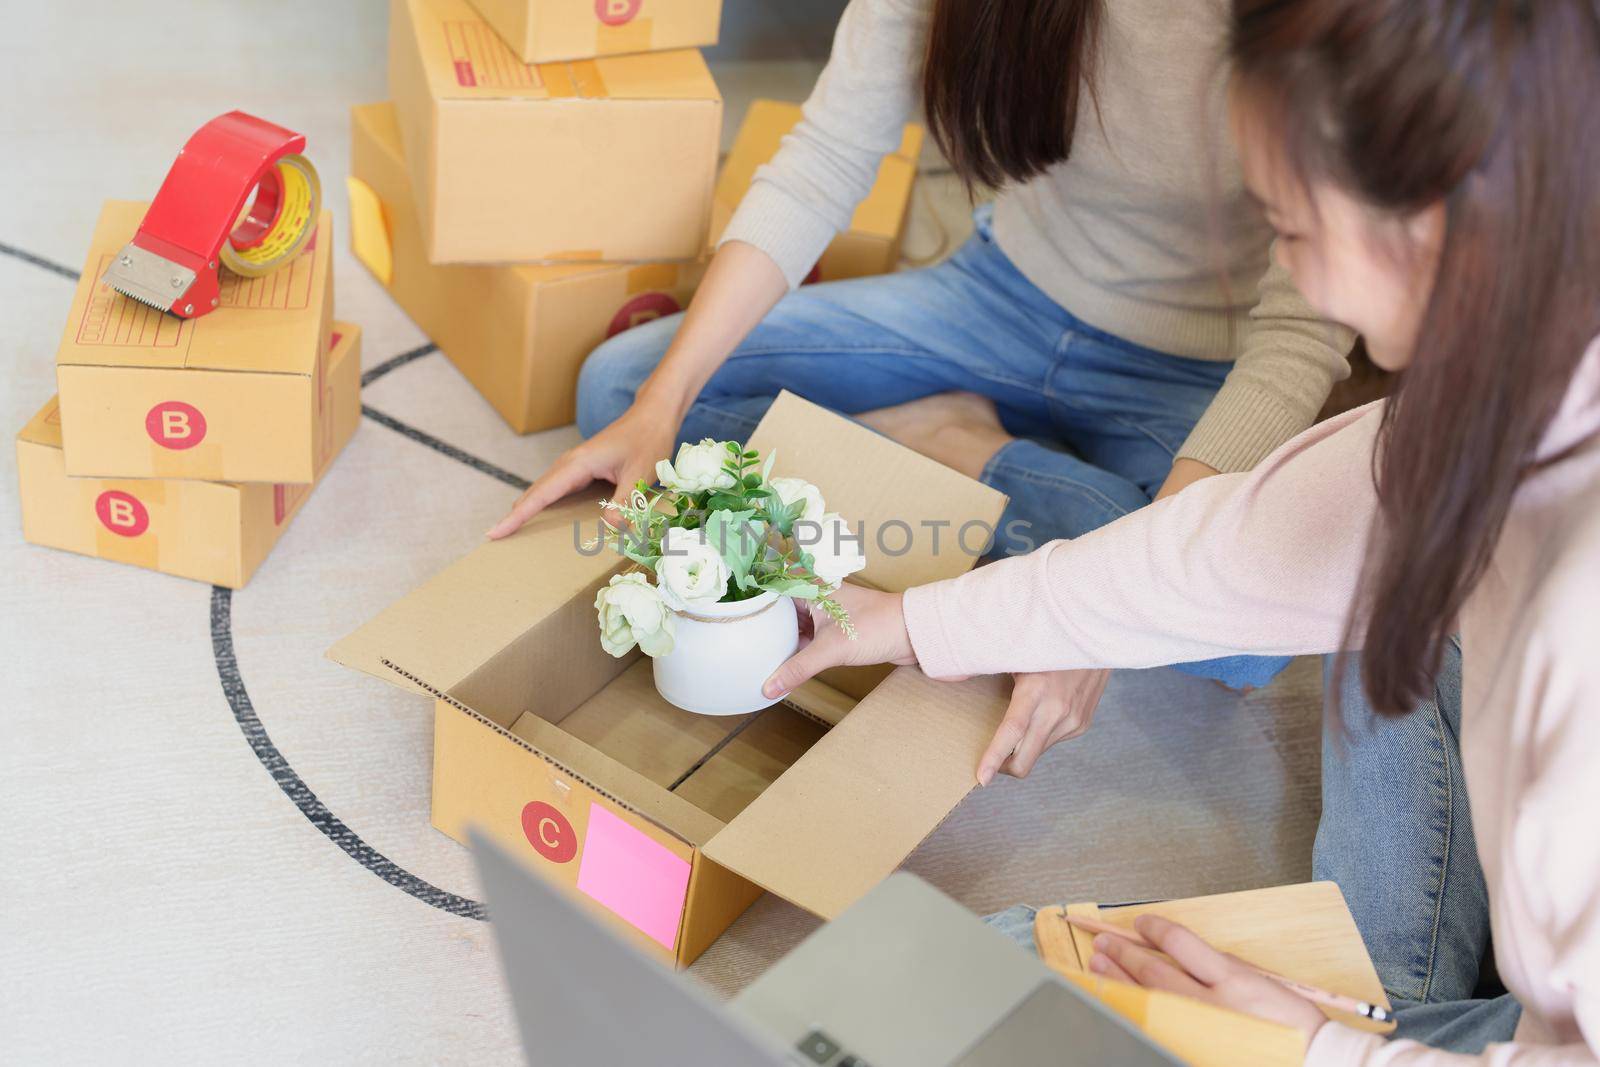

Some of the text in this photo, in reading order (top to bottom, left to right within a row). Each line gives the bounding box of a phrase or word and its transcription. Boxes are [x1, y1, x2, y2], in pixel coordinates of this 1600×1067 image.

[162, 411, 191, 439] B
[109, 497, 137, 528] B
[538, 817, 561, 848] C
